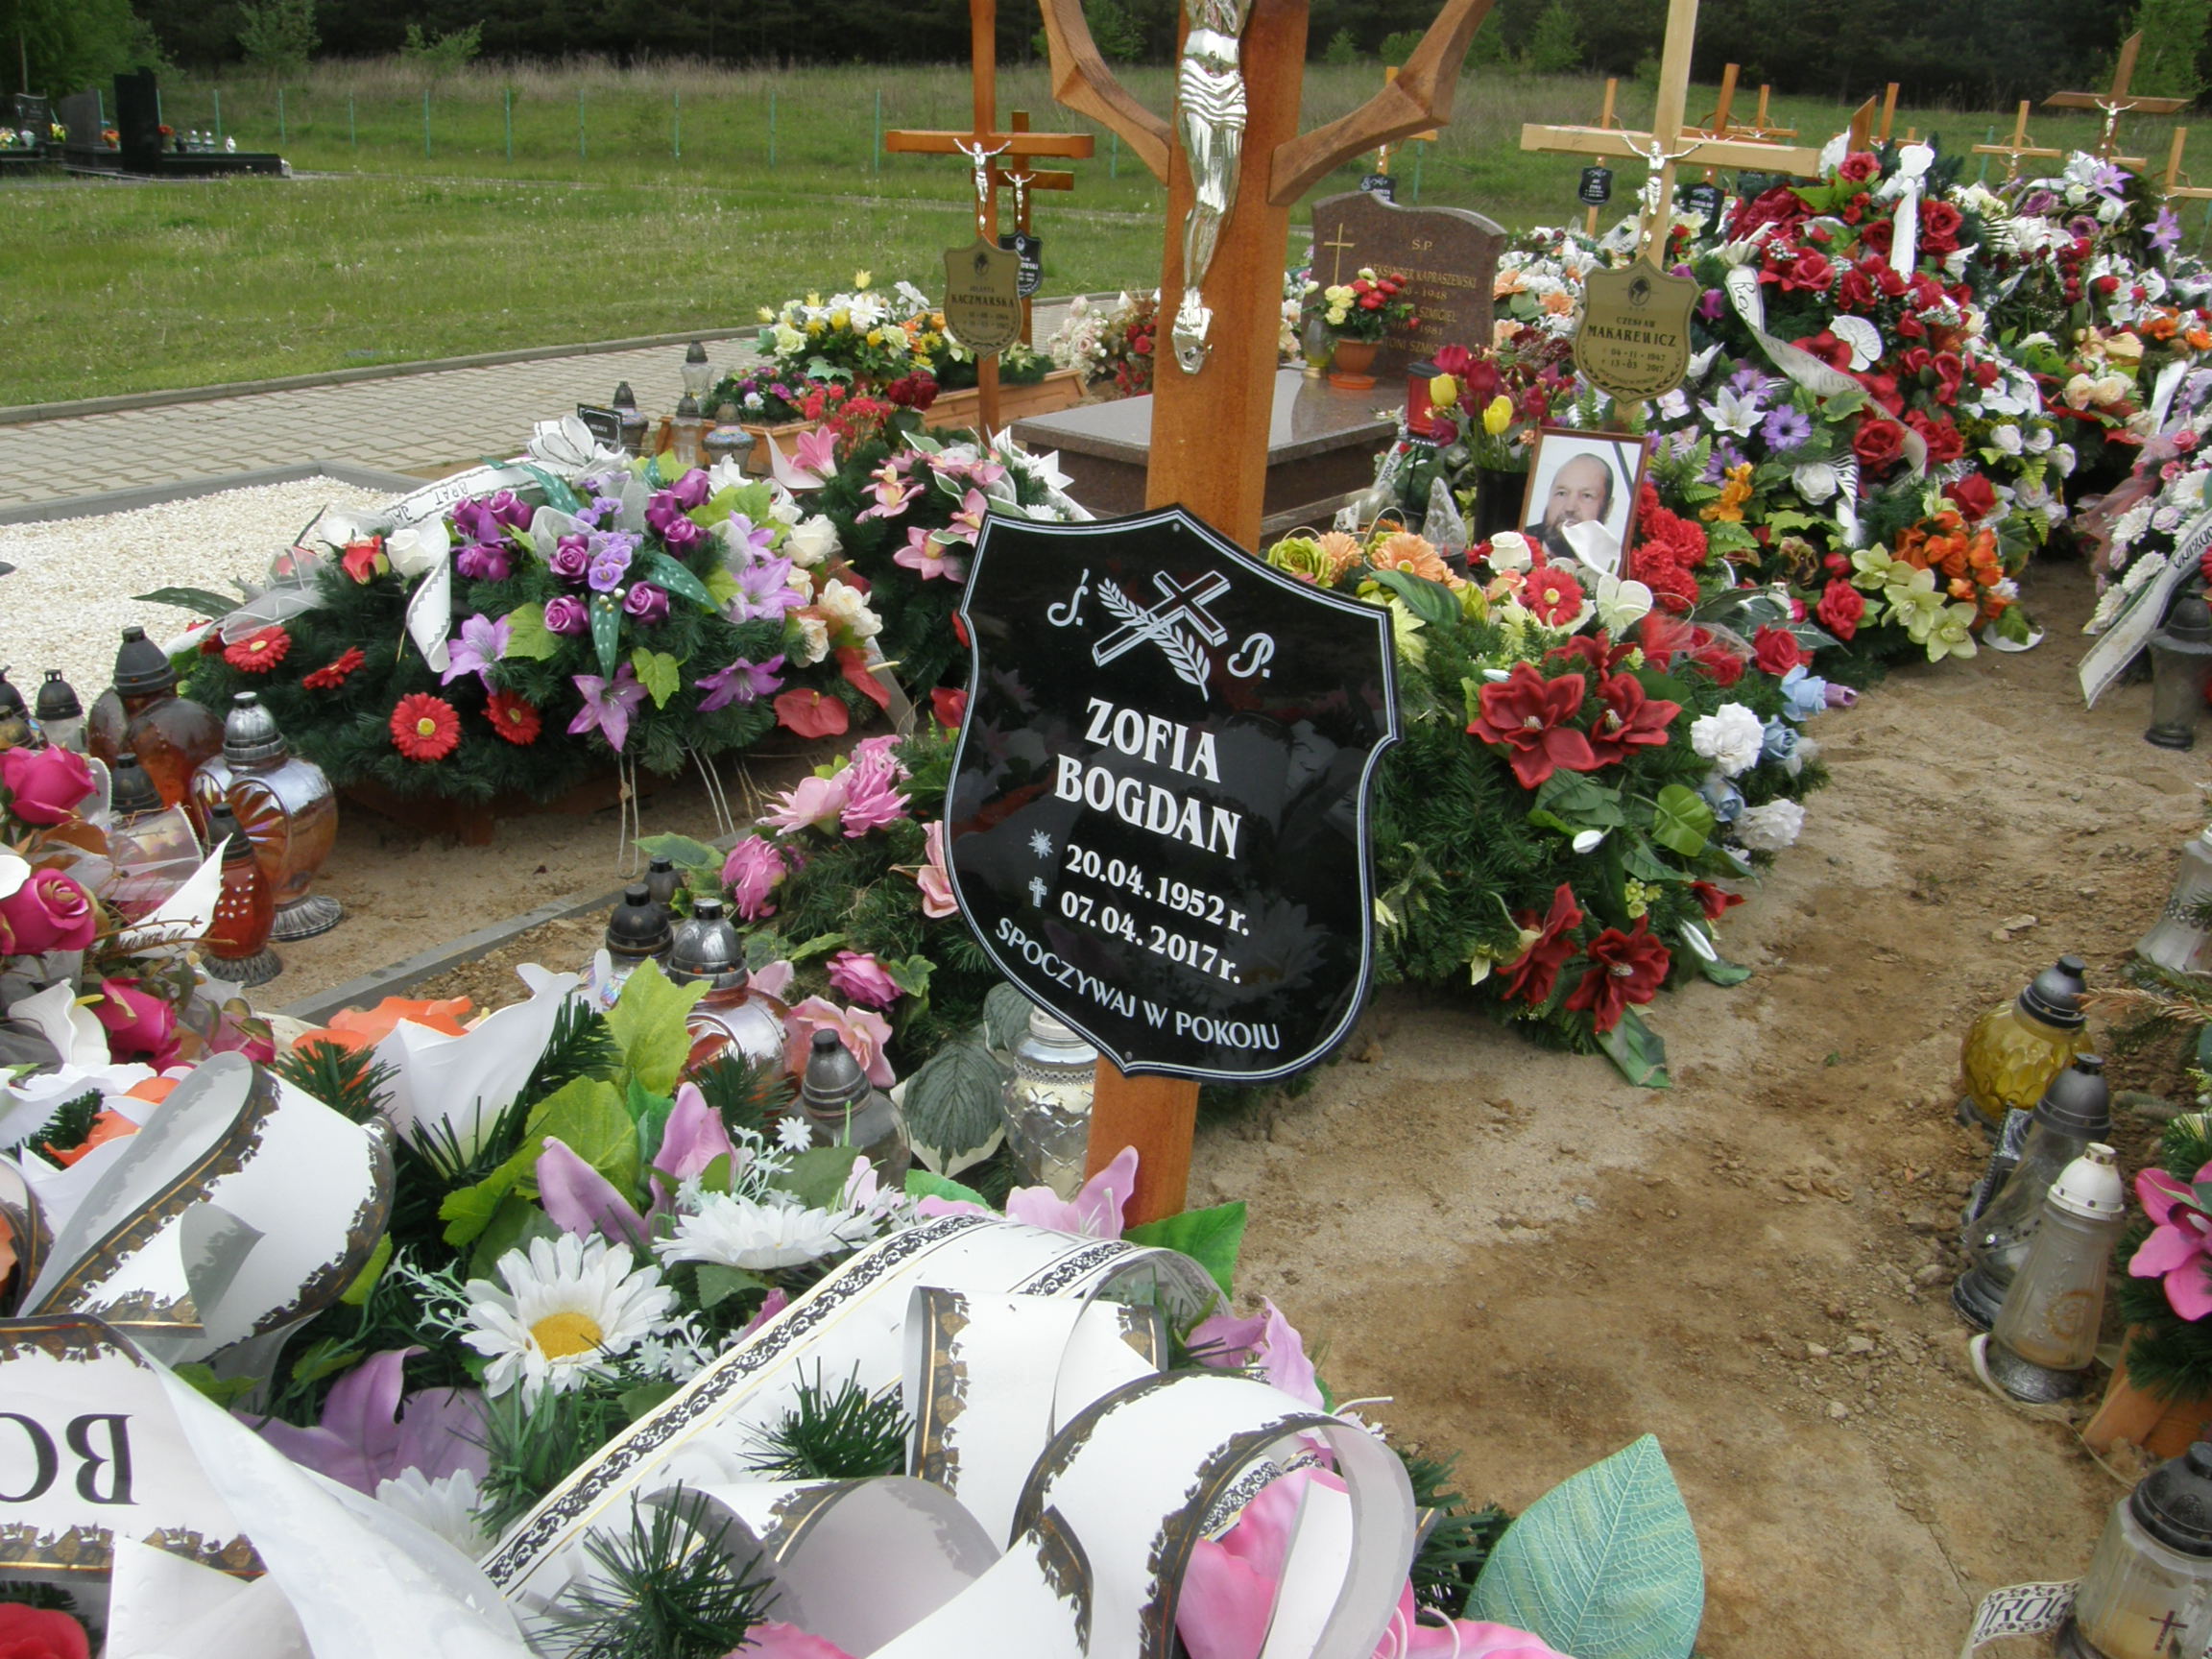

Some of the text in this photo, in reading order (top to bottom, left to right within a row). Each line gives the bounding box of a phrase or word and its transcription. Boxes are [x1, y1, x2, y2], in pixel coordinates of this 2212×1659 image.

[1587, 325, 1677, 347] MAKAREWICZ
[1084, 697, 1221, 783] ZOFIA
[1054, 753, 1242, 860] BOGDAN
[996, 917, 1280, 1050] SPOCZYWAJ W POKOJU
